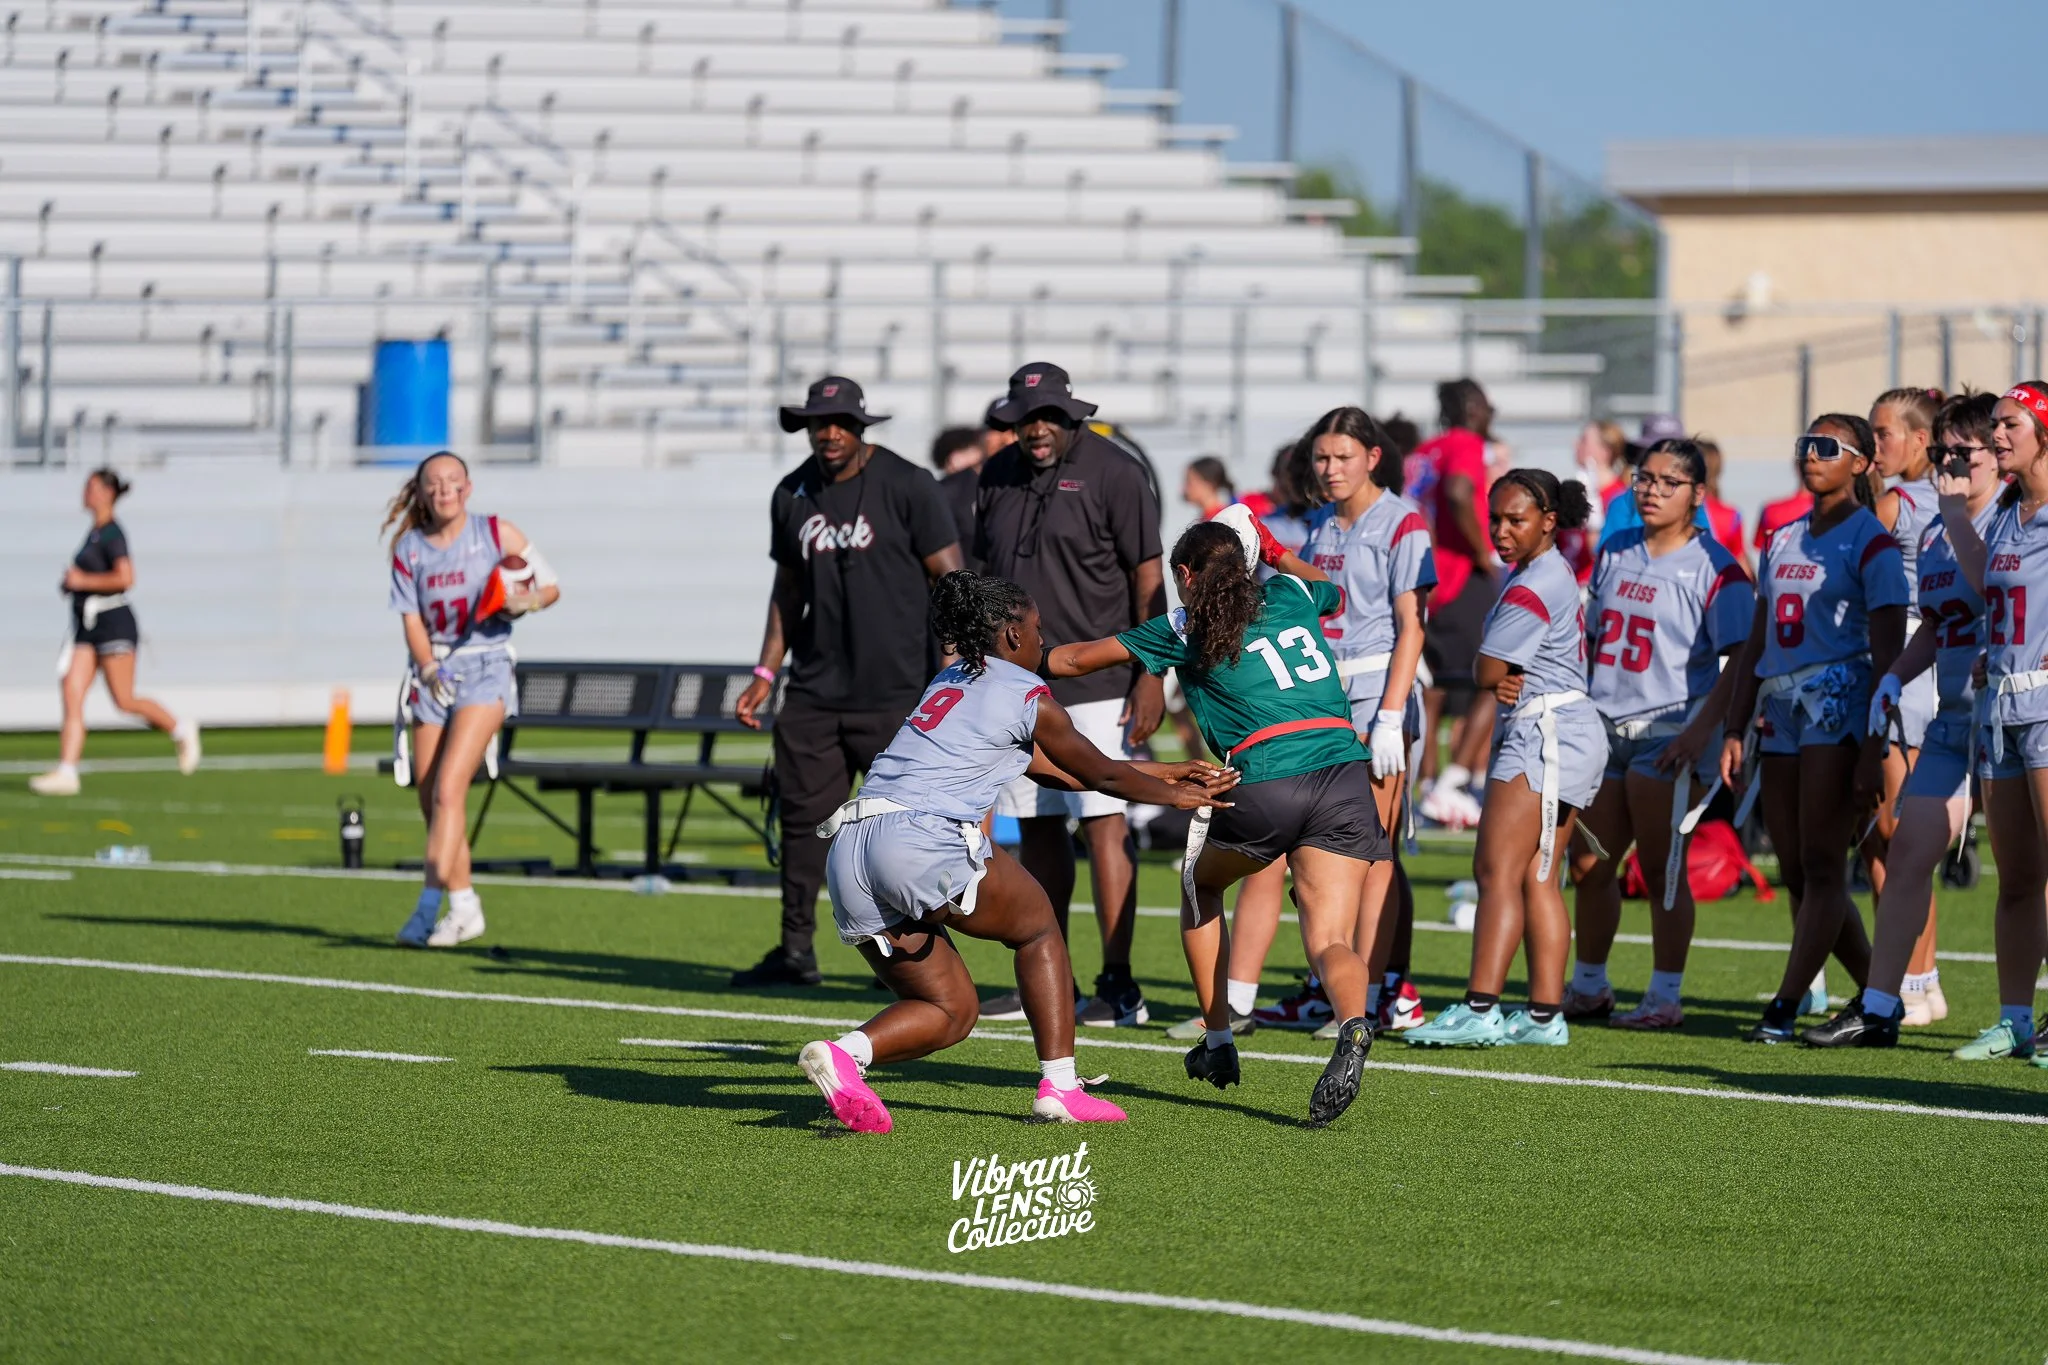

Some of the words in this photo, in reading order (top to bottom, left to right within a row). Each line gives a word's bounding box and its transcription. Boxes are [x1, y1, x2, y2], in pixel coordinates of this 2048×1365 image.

[798, 512, 875, 561] Pack
[426, 570, 465, 590] WEISS
[1616, 580, 1656, 604] WEISS
[1776, 564, 1818, 580] WEISS
[1920, 570, 1956, 592] WEISS
[429, 597, 467, 637] 11
[1776, 592, 1804, 649] 8
[1986, 585, 2026, 645] 21
[1244, 625, 1332, 691] 13
[1594, 608, 1656, 673] 25
[910, 687, 964, 732] 9
